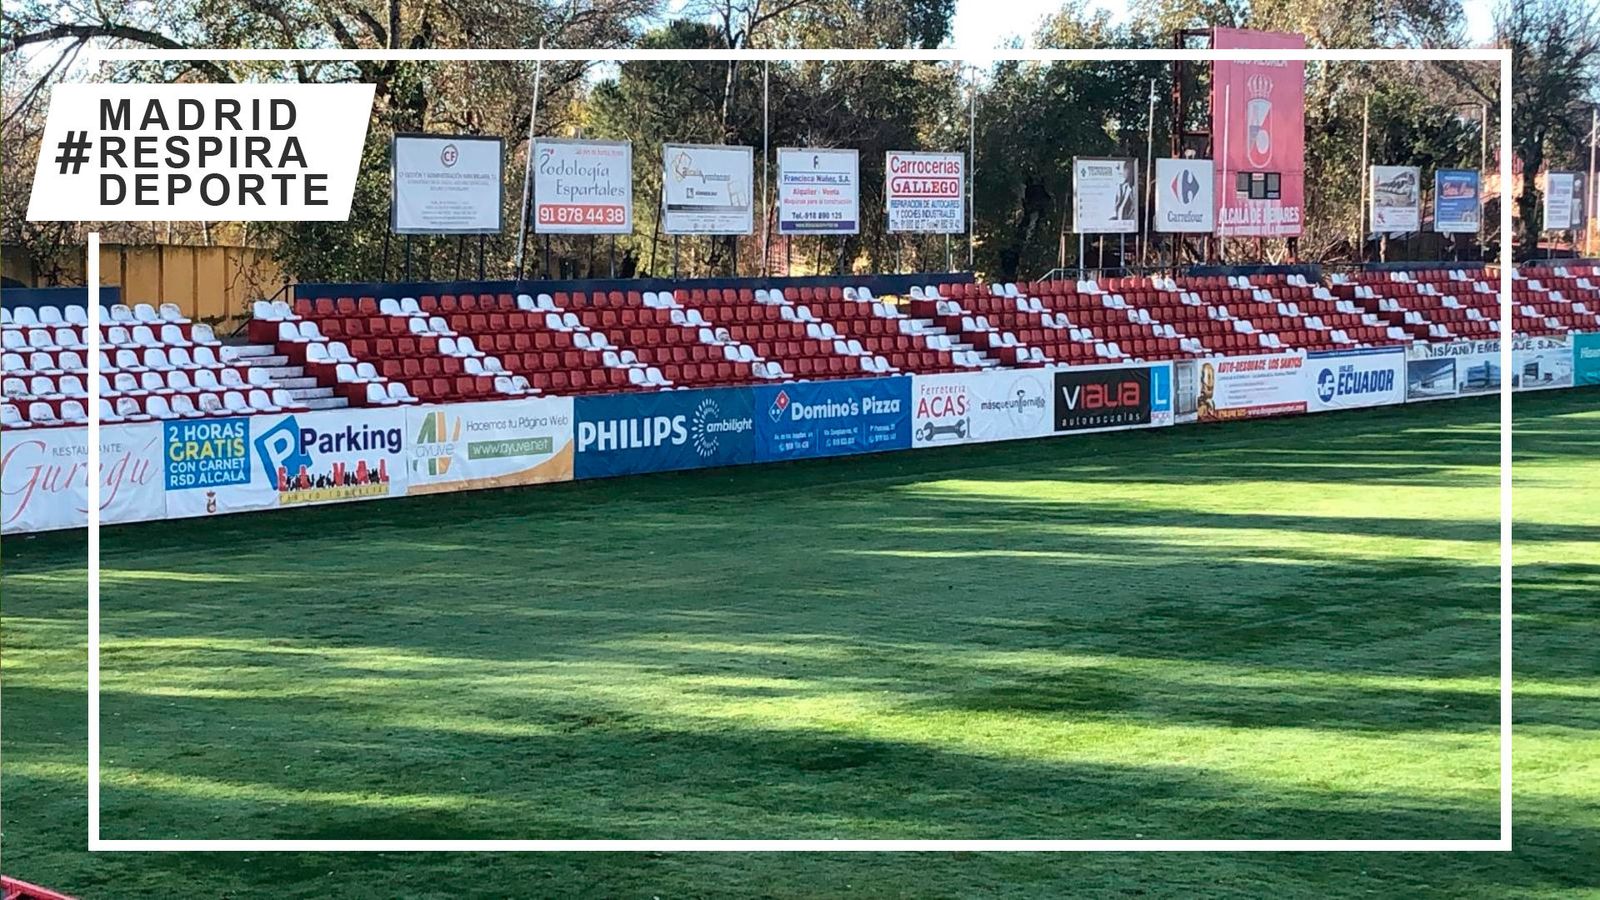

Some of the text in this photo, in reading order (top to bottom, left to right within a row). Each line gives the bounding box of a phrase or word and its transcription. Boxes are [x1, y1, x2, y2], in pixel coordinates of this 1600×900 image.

[890, 155, 960, 174] Carrocerías
[556, 179, 625, 202] Espartales
[891, 179, 958, 194] GALLEGO
[540, 207, 624, 223] 91 878 44 38
[1167, 211, 1203, 223] Carrefour
[1154, 372, 1167, 405] L
[1337, 369, 1395, 396] ECUADOR
[791, 396, 901, 421] Domino's Pizza
[466, 415, 568, 432] Hacemos tu Página Web
[706, 417, 753, 433] ambilight
[1062, 412, 1141, 427] autoescuelas
[169, 422, 245, 443] 2 HORAS
[300, 424, 402, 455] Parking
[578, 415, 688, 452] PHILIPS
[169, 438, 246, 461] GRATIS
[170, 457, 246, 475] CON CARNET
[170, 469, 246, 487] RSD ALCALÁ
